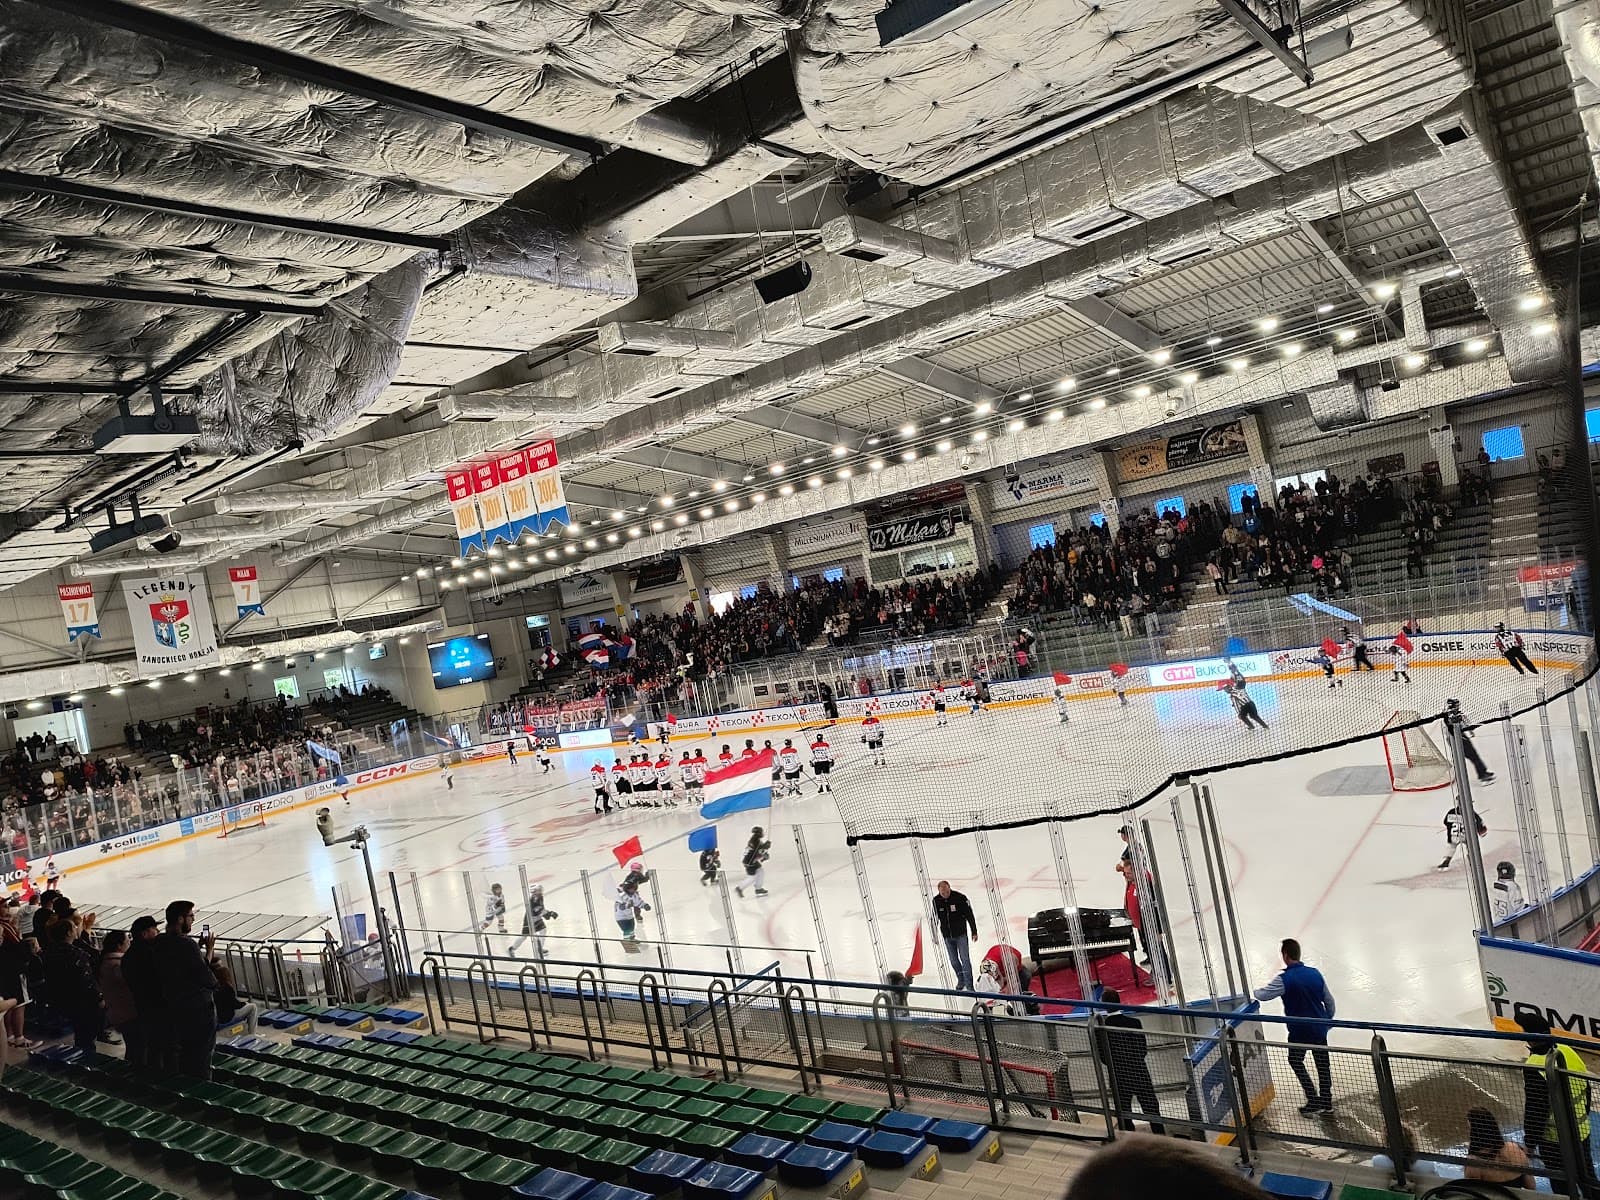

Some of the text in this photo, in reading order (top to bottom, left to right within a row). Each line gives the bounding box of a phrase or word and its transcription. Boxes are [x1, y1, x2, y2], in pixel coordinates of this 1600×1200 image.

[1028, 474, 1063, 487] MARMA
[886, 521, 940, 543] Milan
[133, 580, 196, 600] LEGENDY
[241, 585, 251, 602] 7
[67, 602, 90, 624] 17
[1421, 641, 1464, 653] OSHEE
[141, 655, 187, 665] SANOCKIEGO
[1163, 662, 1257, 681] GTM BUKOSKI
[883, 698, 920, 710] TEXOM
[720, 718, 751, 728] TEXOM
[765, 713, 797, 723] TEXOM
[356, 764, 408, 784] CCM
[253, 795, 294, 813] REZDRO
[114, 831, 160, 848] cellfast
